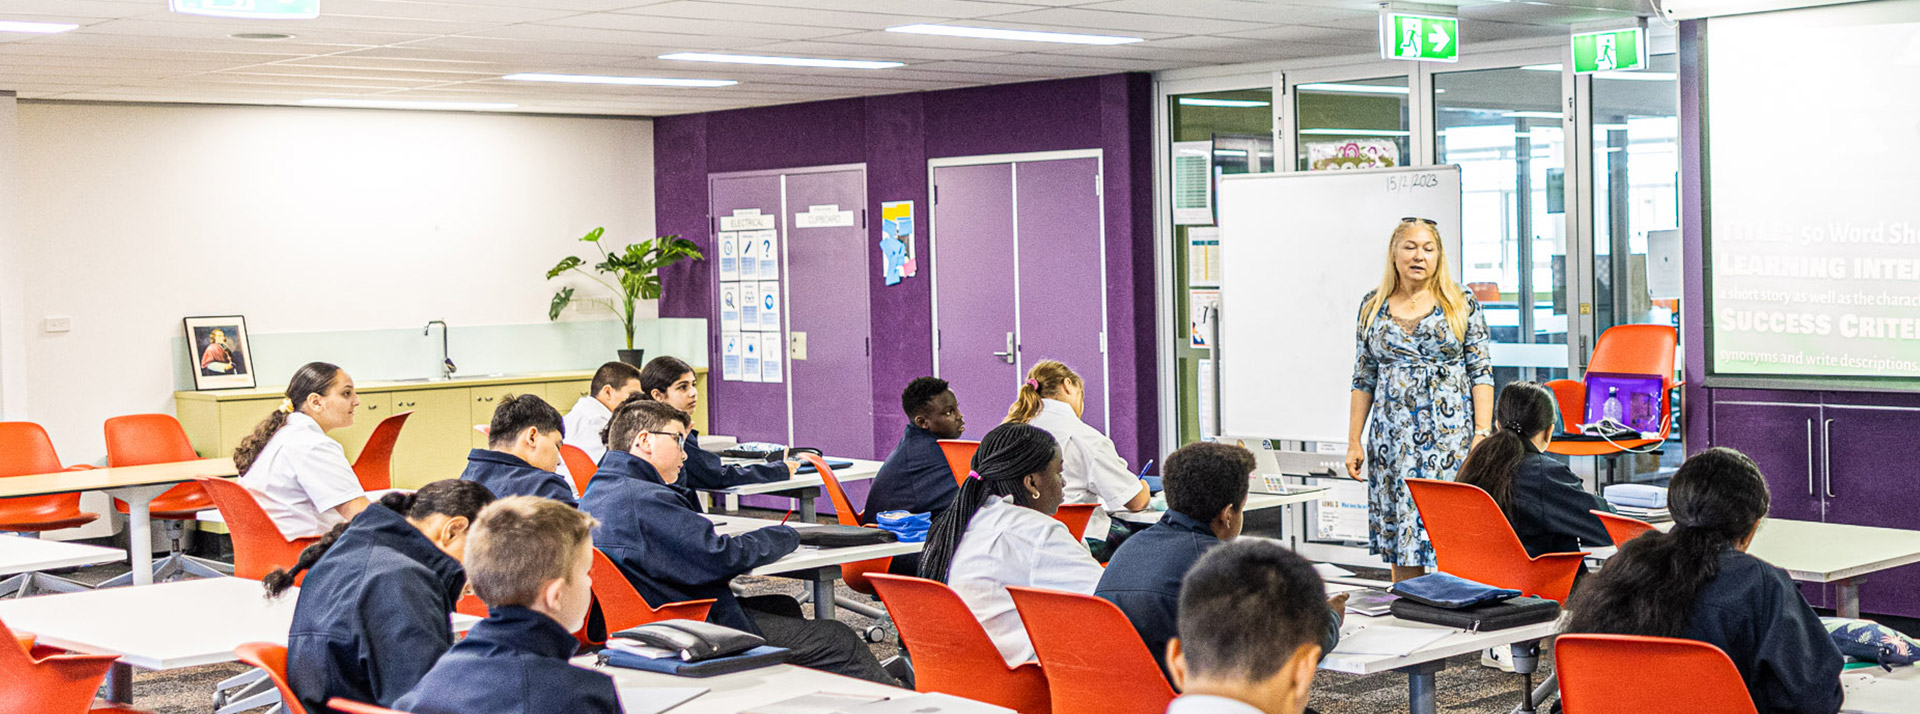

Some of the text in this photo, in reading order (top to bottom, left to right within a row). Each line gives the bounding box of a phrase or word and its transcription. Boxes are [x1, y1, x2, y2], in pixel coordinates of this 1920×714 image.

[1828, 221, 1885, 243] Word
[1719, 252, 1847, 279] LEARNING
[1727, 287, 1759, 301] short
[1760, 288, 1791, 305] story
[1793, 293, 1807, 303] as
[1809, 291, 1836, 304] well
[1838, 294, 1852, 304] as
[1853, 292, 1875, 305] the
[1719, 308, 1832, 335] SUCCESS
[1720, 349, 1778, 365] synonyms
[1780, 351, 1804, 365] and
[1805, 352, 1838, 367] write
